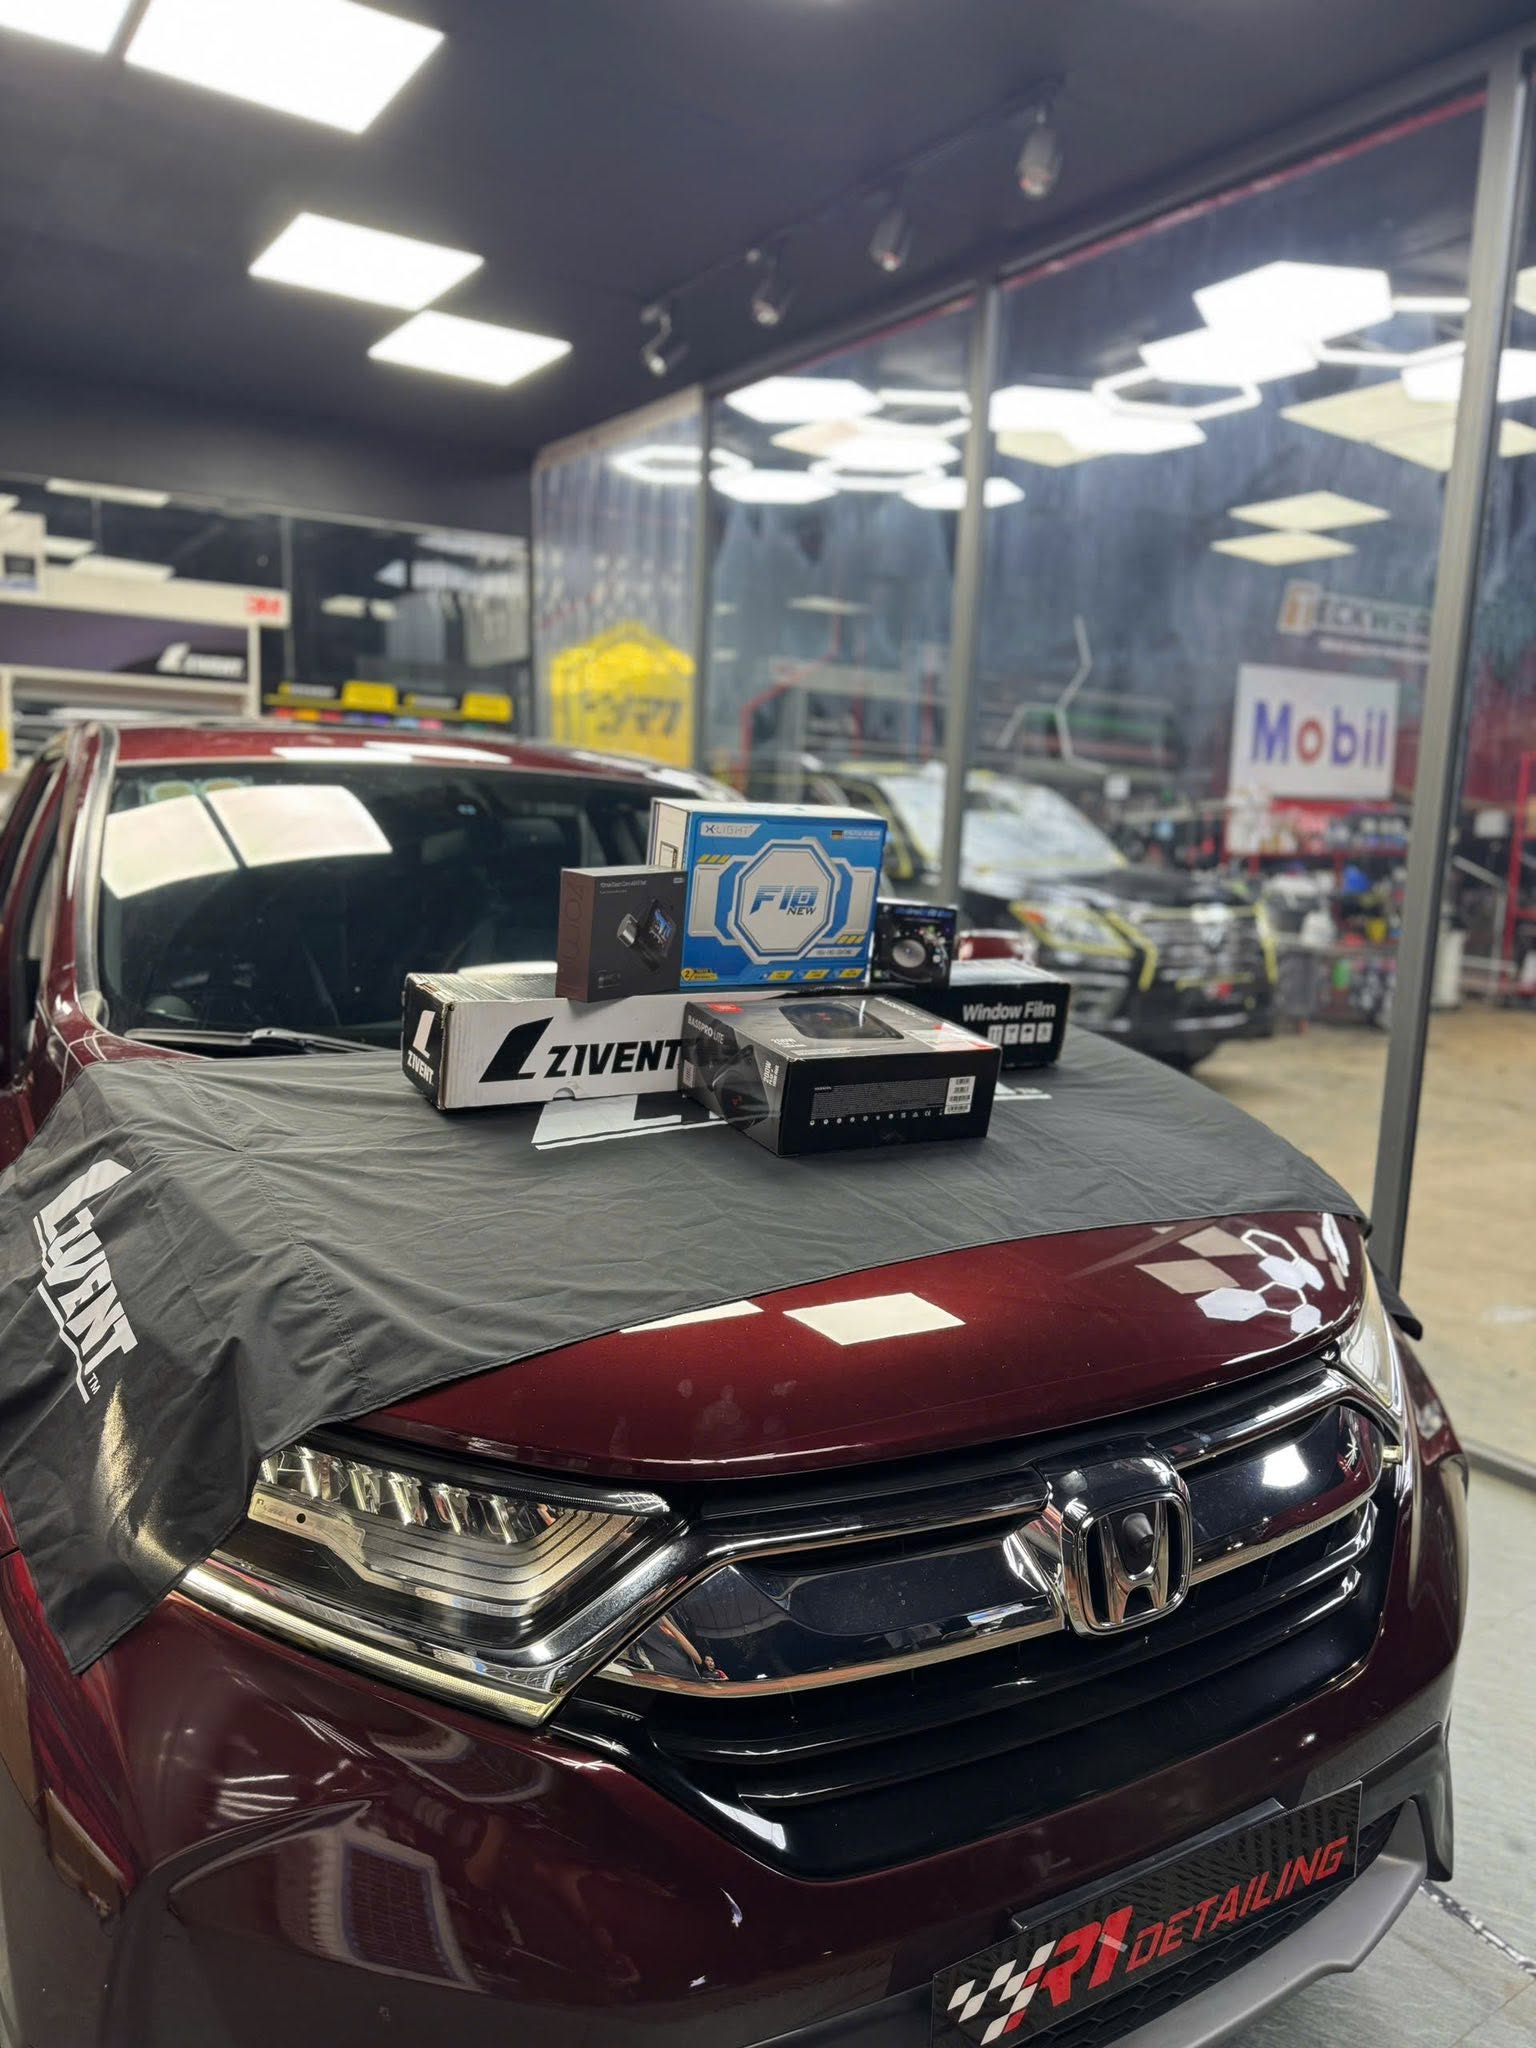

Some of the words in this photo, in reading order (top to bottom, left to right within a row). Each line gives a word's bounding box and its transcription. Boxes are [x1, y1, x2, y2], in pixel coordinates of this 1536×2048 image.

[1252, 701, 1388, 767] Mobil
[750, 885, 820, 916] F10
[786, 907, 817, 916] NEW
[962, 1004, 1022, 1022] Window
[1023, 1001, 1057, 1019] Film
[407, 1050, 435, 1086] ZIVENT
[544, 1038, 683, 1080] ZIVENT
[1125, 1835, 1348, 1973] DETAILING
